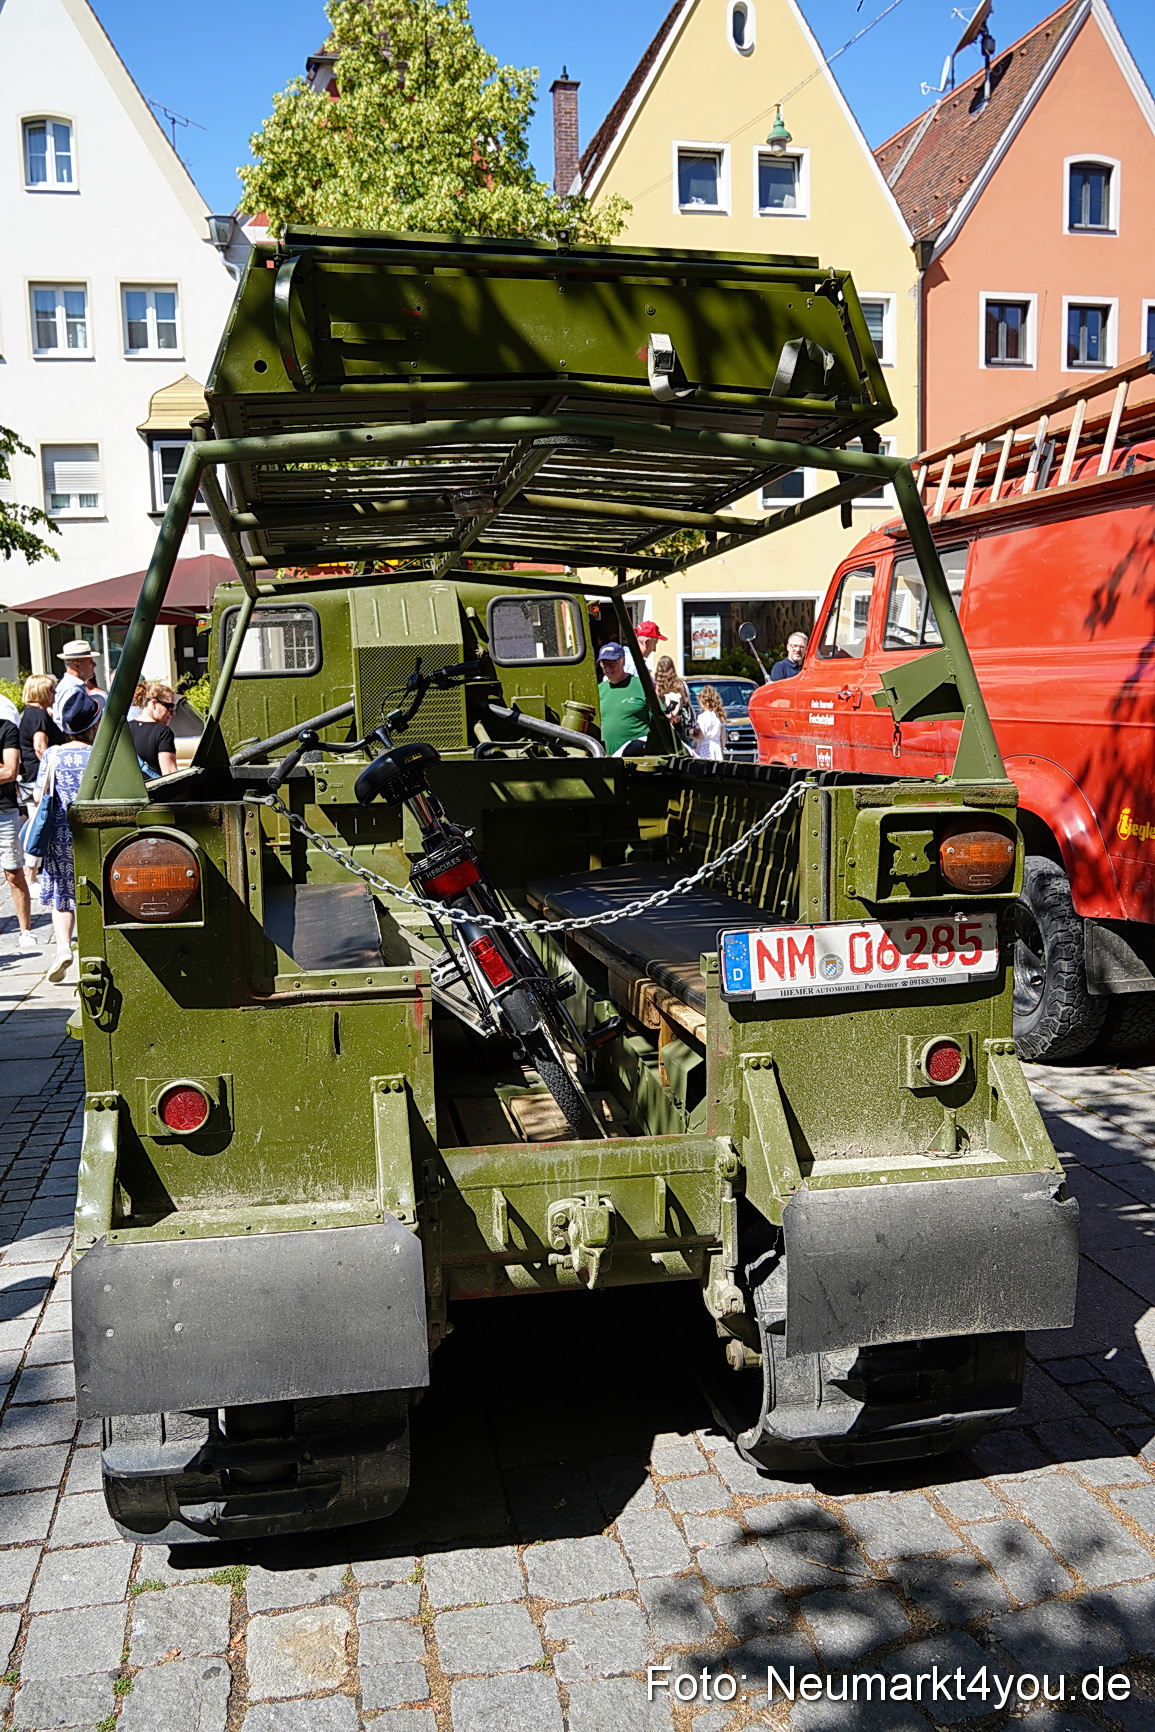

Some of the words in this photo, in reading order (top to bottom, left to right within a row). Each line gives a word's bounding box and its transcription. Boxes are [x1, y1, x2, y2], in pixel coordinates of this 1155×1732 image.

[426, 856, 461, 878] HERCULES
[756, 934, 816, 982] NM
[849, 922, 983, 974] 06285
[733, 968, 744, 981] D
[780, 987, 814, 997] HIEMER
[815, 984, 861, 995] AUTOMOBILE
[864, 980, 899, 990] Postbauer
[909, 976, 947, 987] 09188/3200
